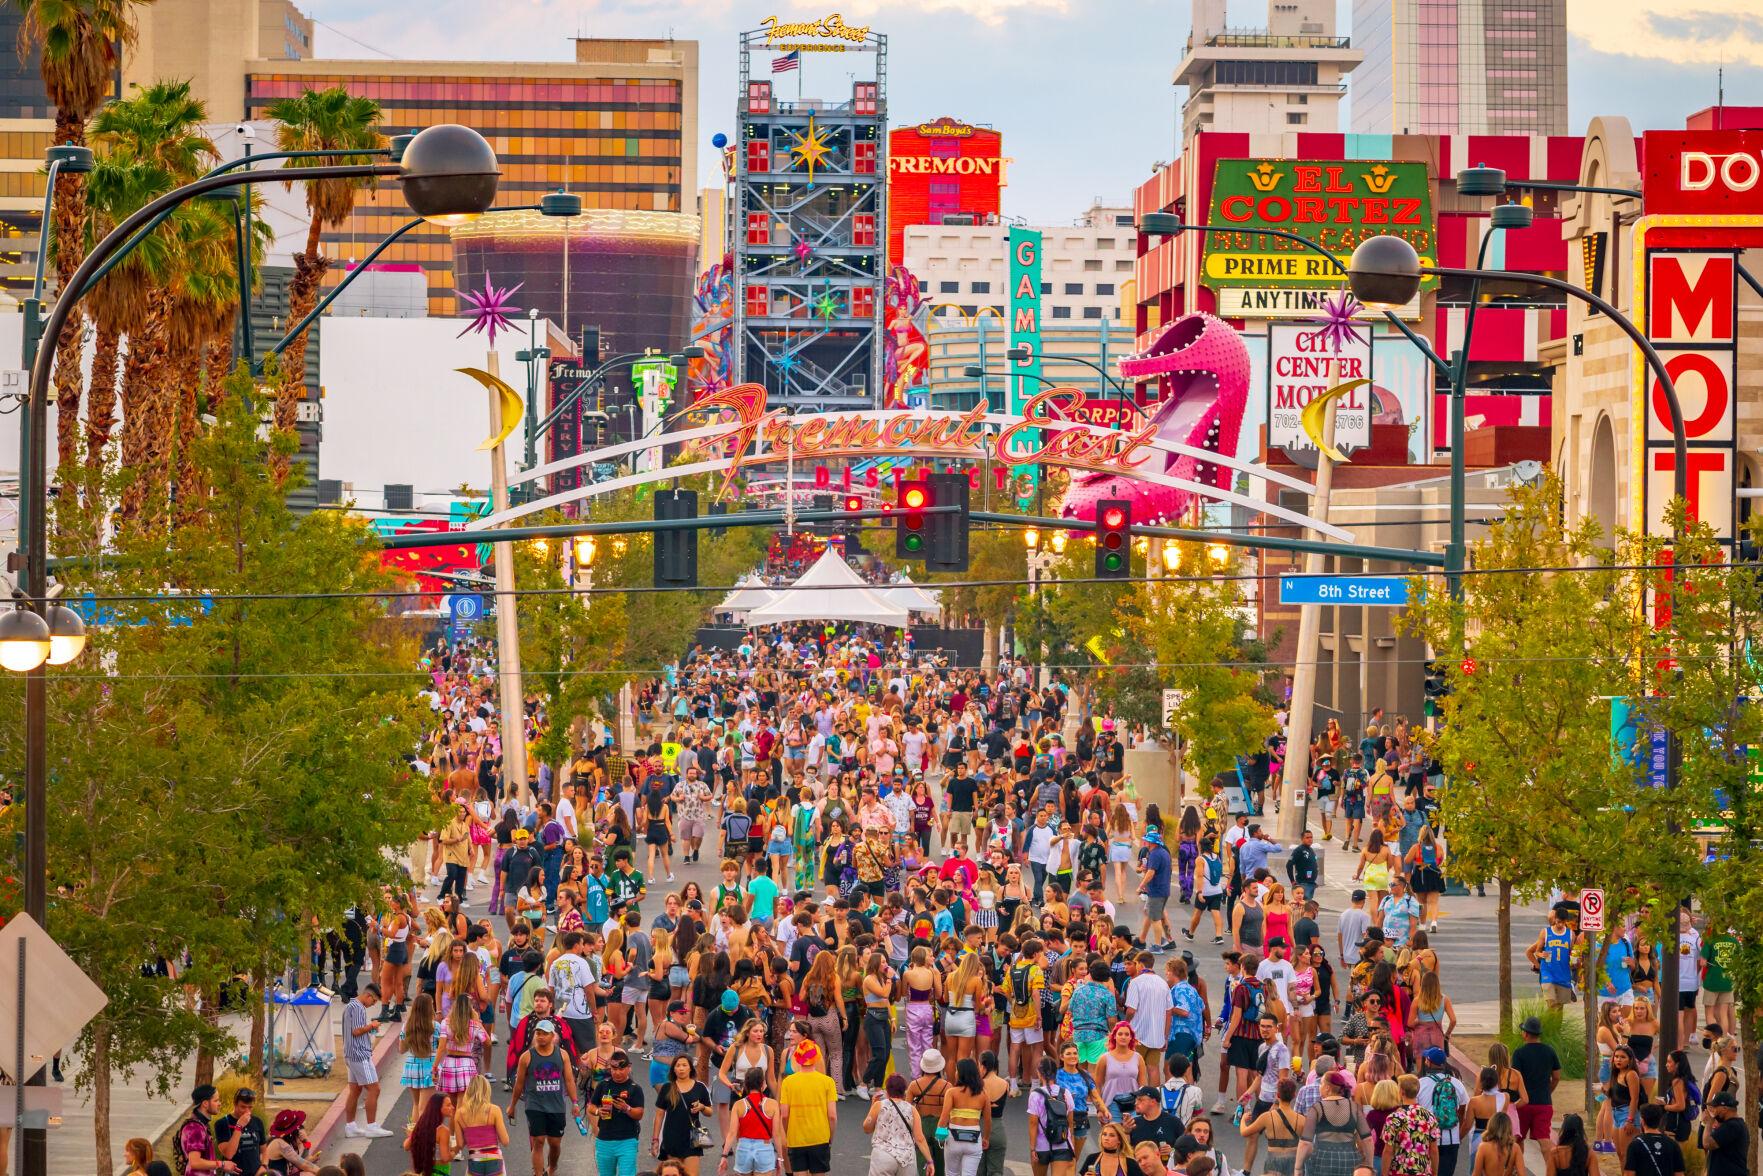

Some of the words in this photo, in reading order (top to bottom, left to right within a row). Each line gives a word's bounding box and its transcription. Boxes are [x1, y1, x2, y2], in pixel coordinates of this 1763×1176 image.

[760, 15, 821, 46] Fremont
[820, 13, 869, 42] Street
[780, 44, 845, 52] EXPERIENCE
[920, 125, 941, 134] Sam
[942, 125, 972, 137] Boyd's
[886, 156, 1015, 186] FREMONT
[1292, 165, 1353, 193] EL
[1681, 149, 1763, 192] DO
[1220, 195, 1422, 224] CORTEZ
[1225, 258, 1297, 275] PRIME
[1241, 290, 1329, 309] ANYTIME
[1295, 331, 1343, 353] CIT
[549, 362, 604, 379] Fremo
[1013, 240, 1037, 498] GAMBLNG
[1276, 356, 1364, 378] CENTER
[1274, 384, 1365, 410] MOTL
[668, 383, 990, 505] Fremont
[996, 387, 1159, 469] East
[816, 466, 1009, 489] DISTCT
[1286, 581, 1293, 589] N
[1318, 584, 1342, 598] 8th
[1348, 584, 1391, 599] Street
[1653, 747, 1665, 770] YOU
[596, 892, 602, 906] 2
[619, 879, 635, 899] 12
[1557, 948, 1561, 961] 1
